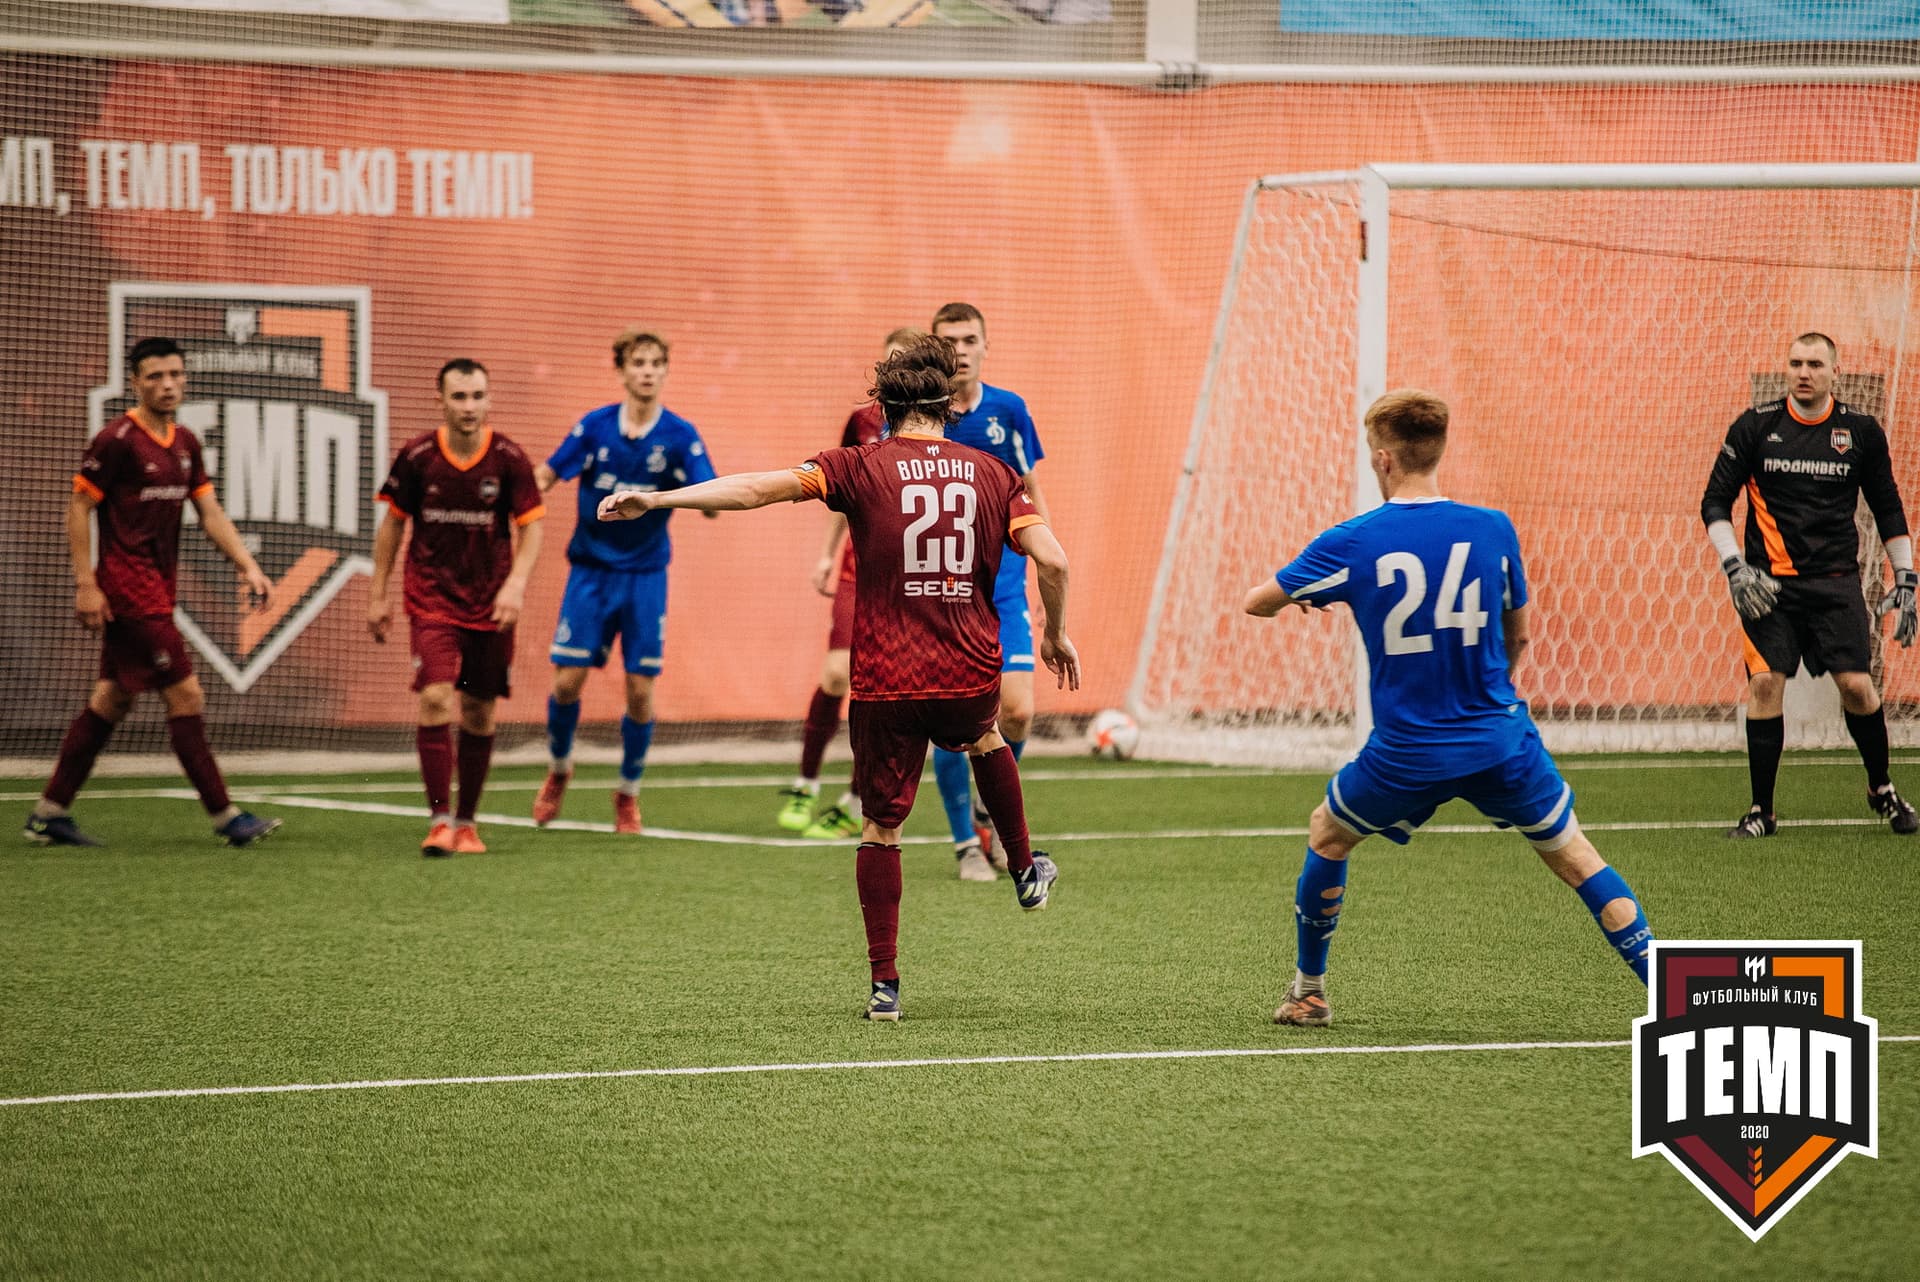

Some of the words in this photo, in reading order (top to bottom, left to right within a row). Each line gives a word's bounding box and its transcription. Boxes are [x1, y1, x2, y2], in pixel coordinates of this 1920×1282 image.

[80, 139, 216, 221] ТЕМП,
[226, 144, 396, 216] ТОЛЬКО
[408, 150, 534, 218] ТЕМП!
[896, 458, 975, 483] ВОРОНА
[1764, 458, 1851, 477] ПРОДИНВЕСТ
[901, 482, 977, 574] 23
[904, 579, 973, 597] SEUS
[1376, 542, 1488, 656] 24
